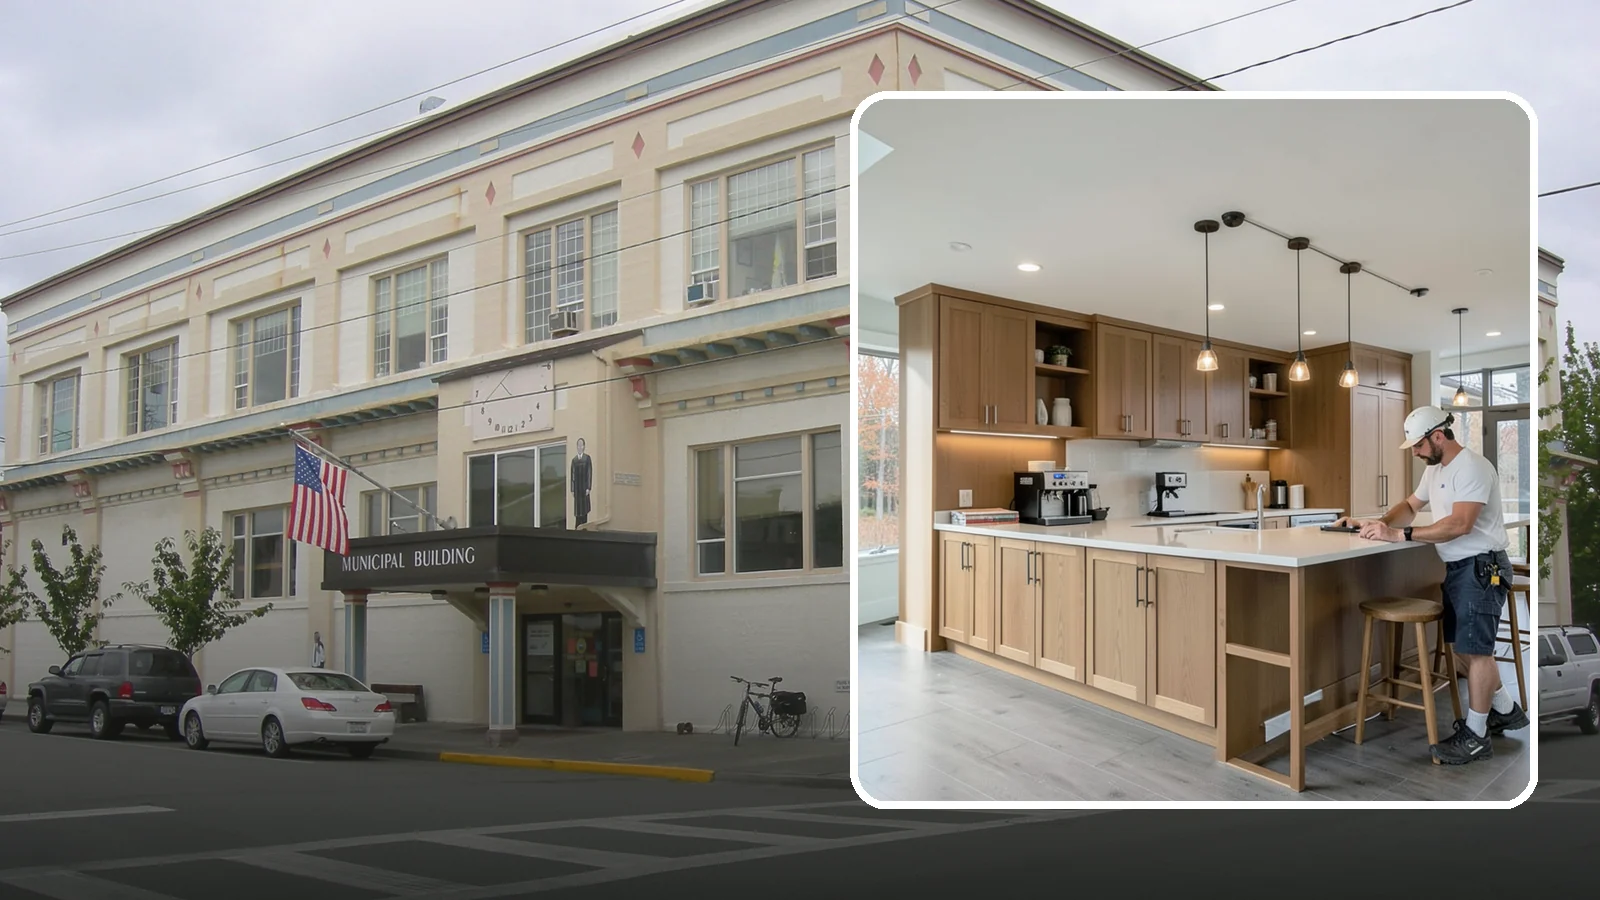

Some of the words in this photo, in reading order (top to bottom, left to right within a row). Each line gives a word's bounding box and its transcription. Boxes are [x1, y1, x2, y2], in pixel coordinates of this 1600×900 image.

[480, 406, 485, 415] 8
[487, 417, 492, 426] 9
[494, 423, 500, 432] 10
[507, 425, 513, 434] 12
[521, 420, 526, 428] 2
[529, 414, 533, 422] 3
[536, 402, 540, 410] 4
[342, 552, 405, 572] MUNICIPAL
[414, 546, 475, 567] BUILDING
